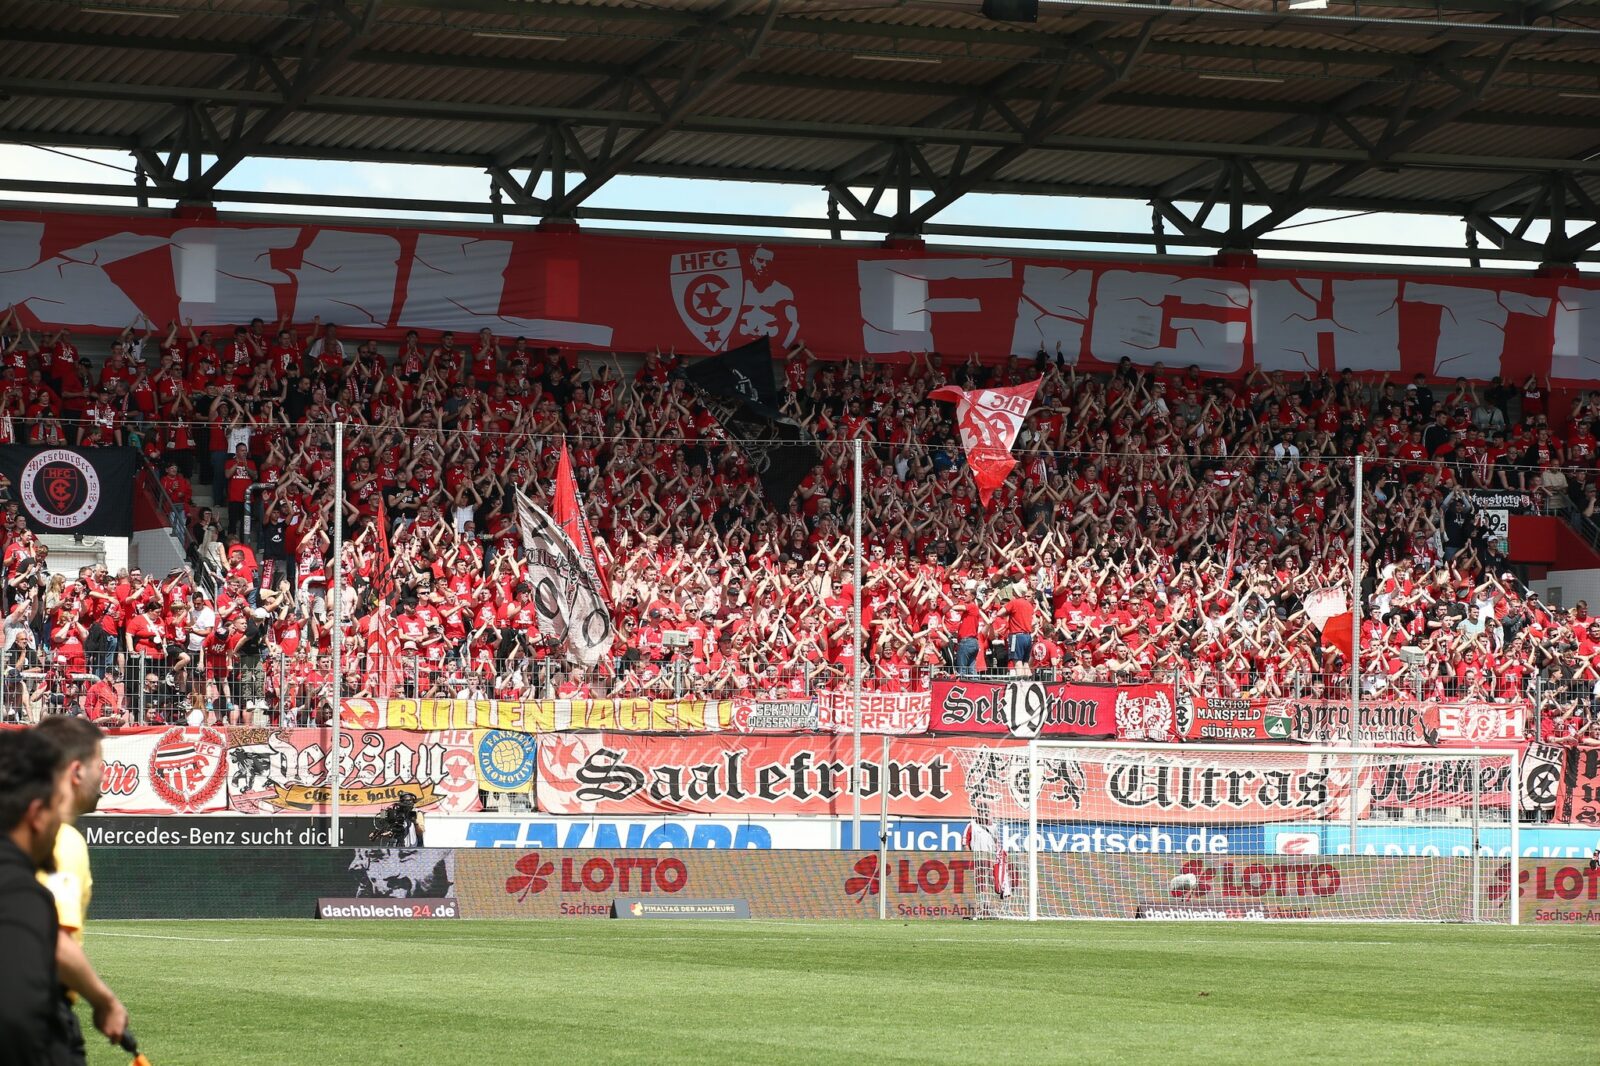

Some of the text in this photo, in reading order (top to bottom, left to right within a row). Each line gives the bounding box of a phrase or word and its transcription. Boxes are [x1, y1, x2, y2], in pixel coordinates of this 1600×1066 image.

[680, 250, 728, 271] HFC
[28, 450, 93, 473] Merseburger
[48, 470, 71, 478] HFC
[44, 513, 78, 528] Jungs
[387, 698, 552, 733] BULLEN
[756, 703, 811, 716] SEKTION
[1197, 708, 1261, 721] MANSFELD
[486, 731, 534, 753] FANSZENE
[1200, 725, 1256, 739] SÜDHARZ
[1315, 726, 1417, 742] ist Ledenschaft
[482, 752, 533, 783] LOKOMOTIVE
[576, 748, 953, 803] Saalefront
[1106, 755, 1331, 809] Ultras
[87, 827, 235, 845] Mercedes-Benz
[241, 827, 293, 845] sucht
[561, 857, 687, 893] LOTTO
[1223, 863, 1341, 898] LOTTO
